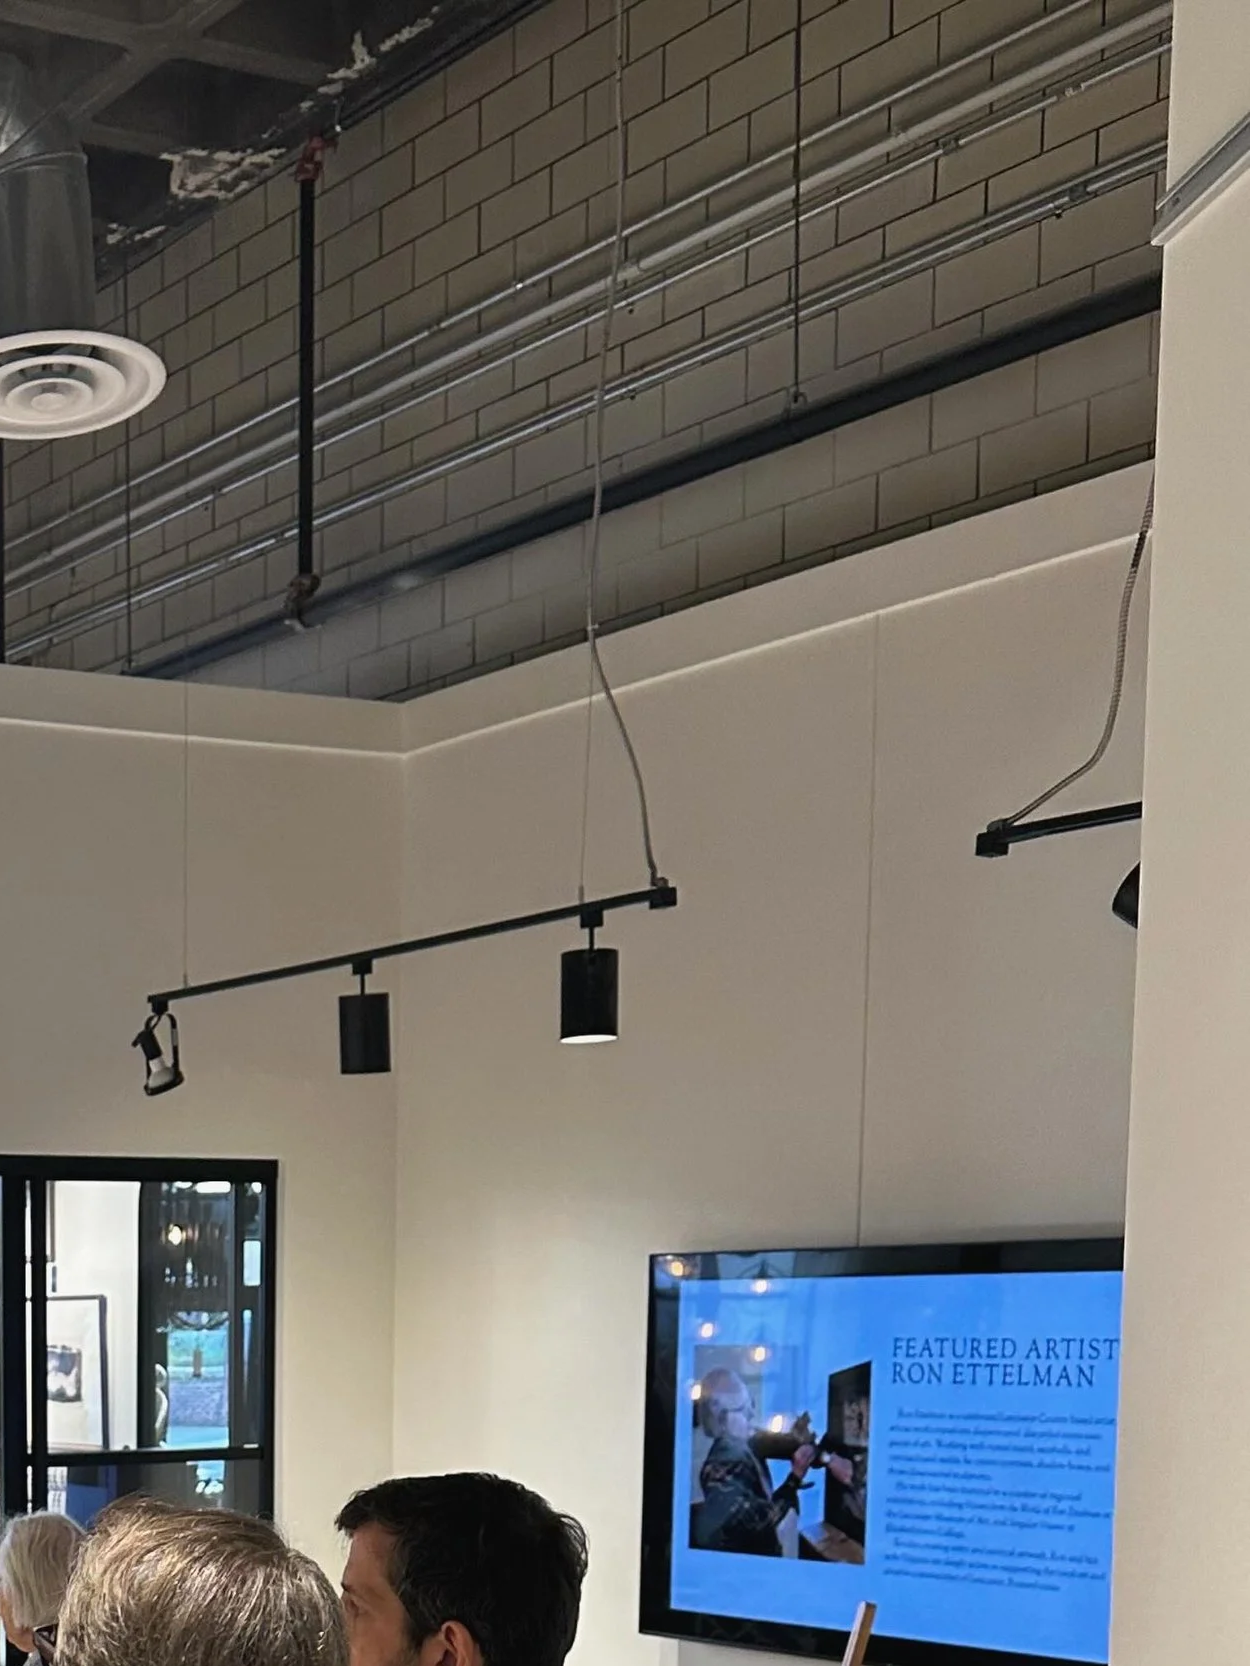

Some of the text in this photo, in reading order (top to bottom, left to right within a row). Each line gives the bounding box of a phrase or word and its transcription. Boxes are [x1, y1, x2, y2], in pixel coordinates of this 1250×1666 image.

[892, 1336, 1119, 1361] FEATURED ARTIST
[892, 1361, 1095, 1388] RON ETTELMAN
